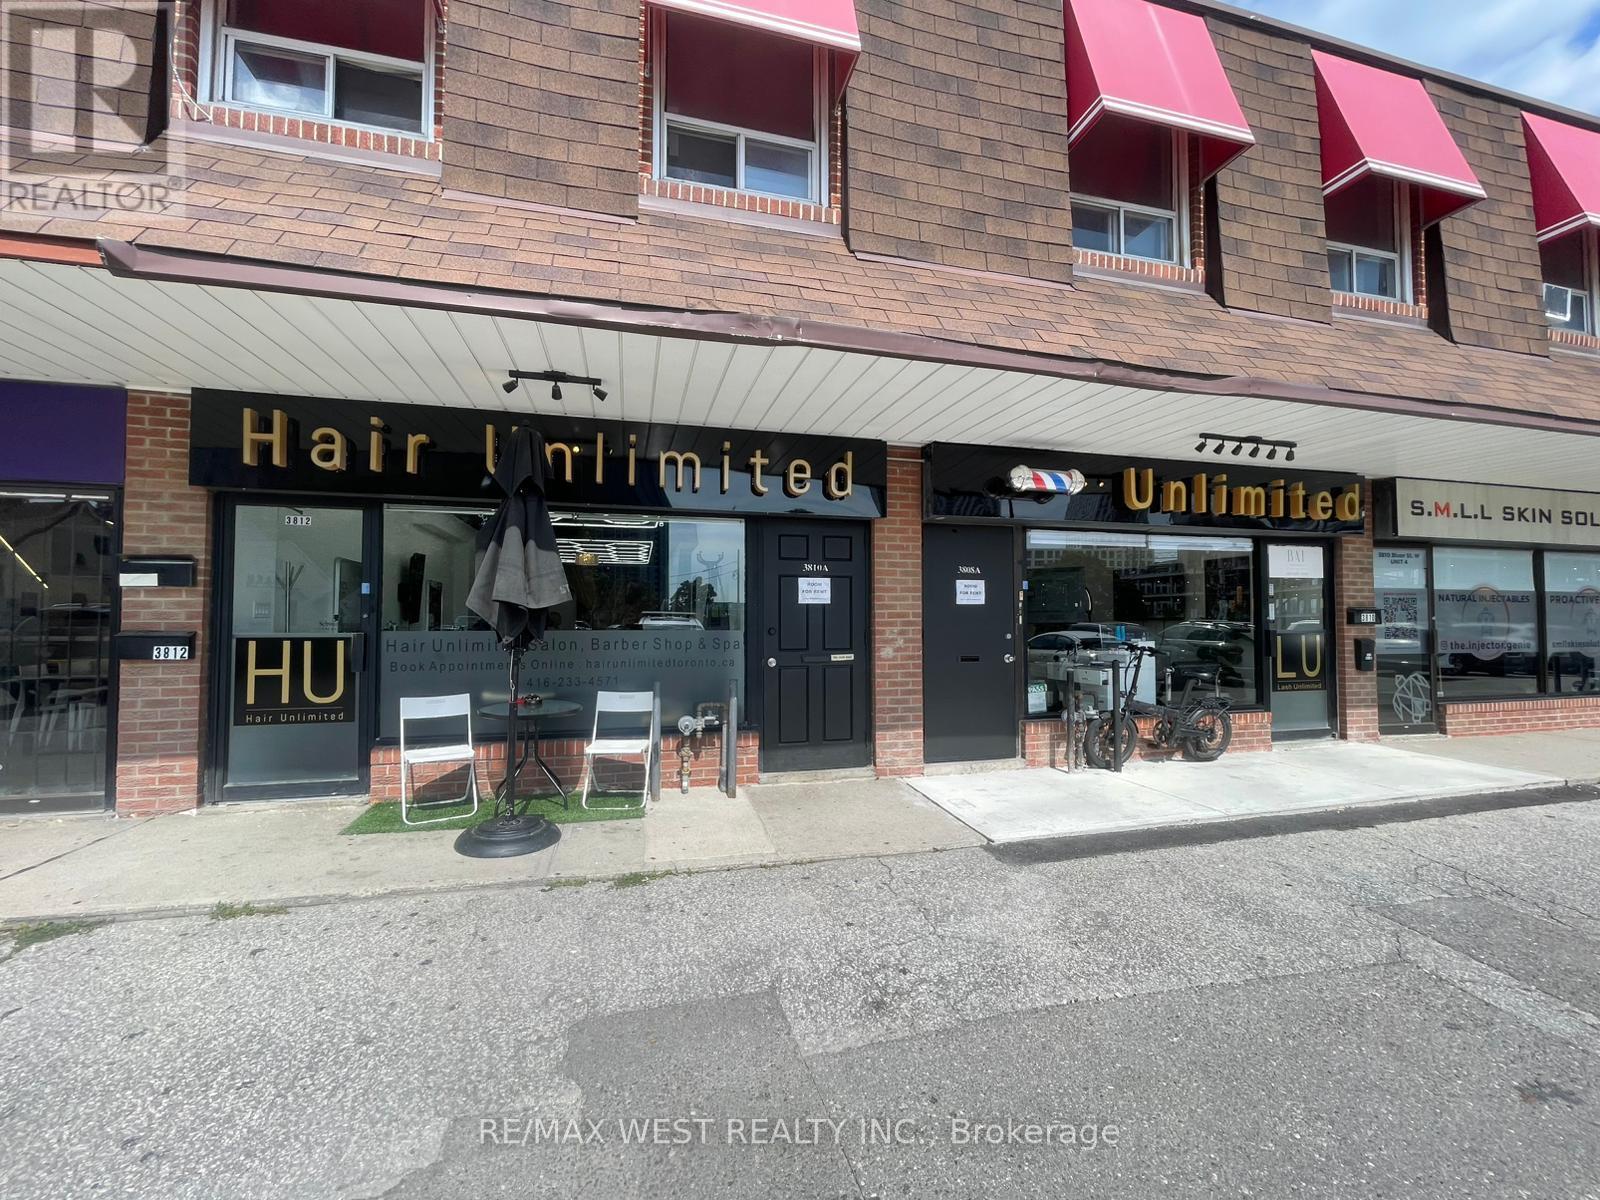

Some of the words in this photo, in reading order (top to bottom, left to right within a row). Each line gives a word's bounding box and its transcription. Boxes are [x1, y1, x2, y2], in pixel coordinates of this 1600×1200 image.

[242, 408, 430, 473] Hair
[1123, 466, 1361, 522] Unlimited
[1411, 500, 1493, 521] S.M.L.L
[1502, 506, 1552, 524] SKIN
[1561, 510, 1600, 527] SOL
[286, 515, 311, 525] 3812
[802, 563, 829, 572] 3810A
[1438, 594, 1476, 603] NATURAL
[1478, 594, 1531, 603] INJECTABLES
[1549, 595, 1600, 604] PROACTIVE
[386, 639, 425, 653] Hair
[432, 638, 513, 653] Unlimit
[591, 637, 647, 651] Barber
[652, 637, 693, 652] Shop
[698, 637, 707, 650] &
[712, 637, 740, 652] Spa
[1450, 640, 1532, 651] the.injector.genie
[154, 647, 187, 660] 3812
[1276, 634, 1321, 679] LU
[390, 661, 425, 672] Book
[430, 660, 525, 673] Appointmens
[531, 659, 574, 670] Online
[585, 657, 735, 670] hairunlimitedtoronto.ca
[246, 640, 345, 705] HU
[526, 676, 619, 688] 416-233-4571
[1293, 681, 1322, 690] Unlimited
[245, 714, 273, 723] Hair
[280, 711, 345, 722] Unlimited
